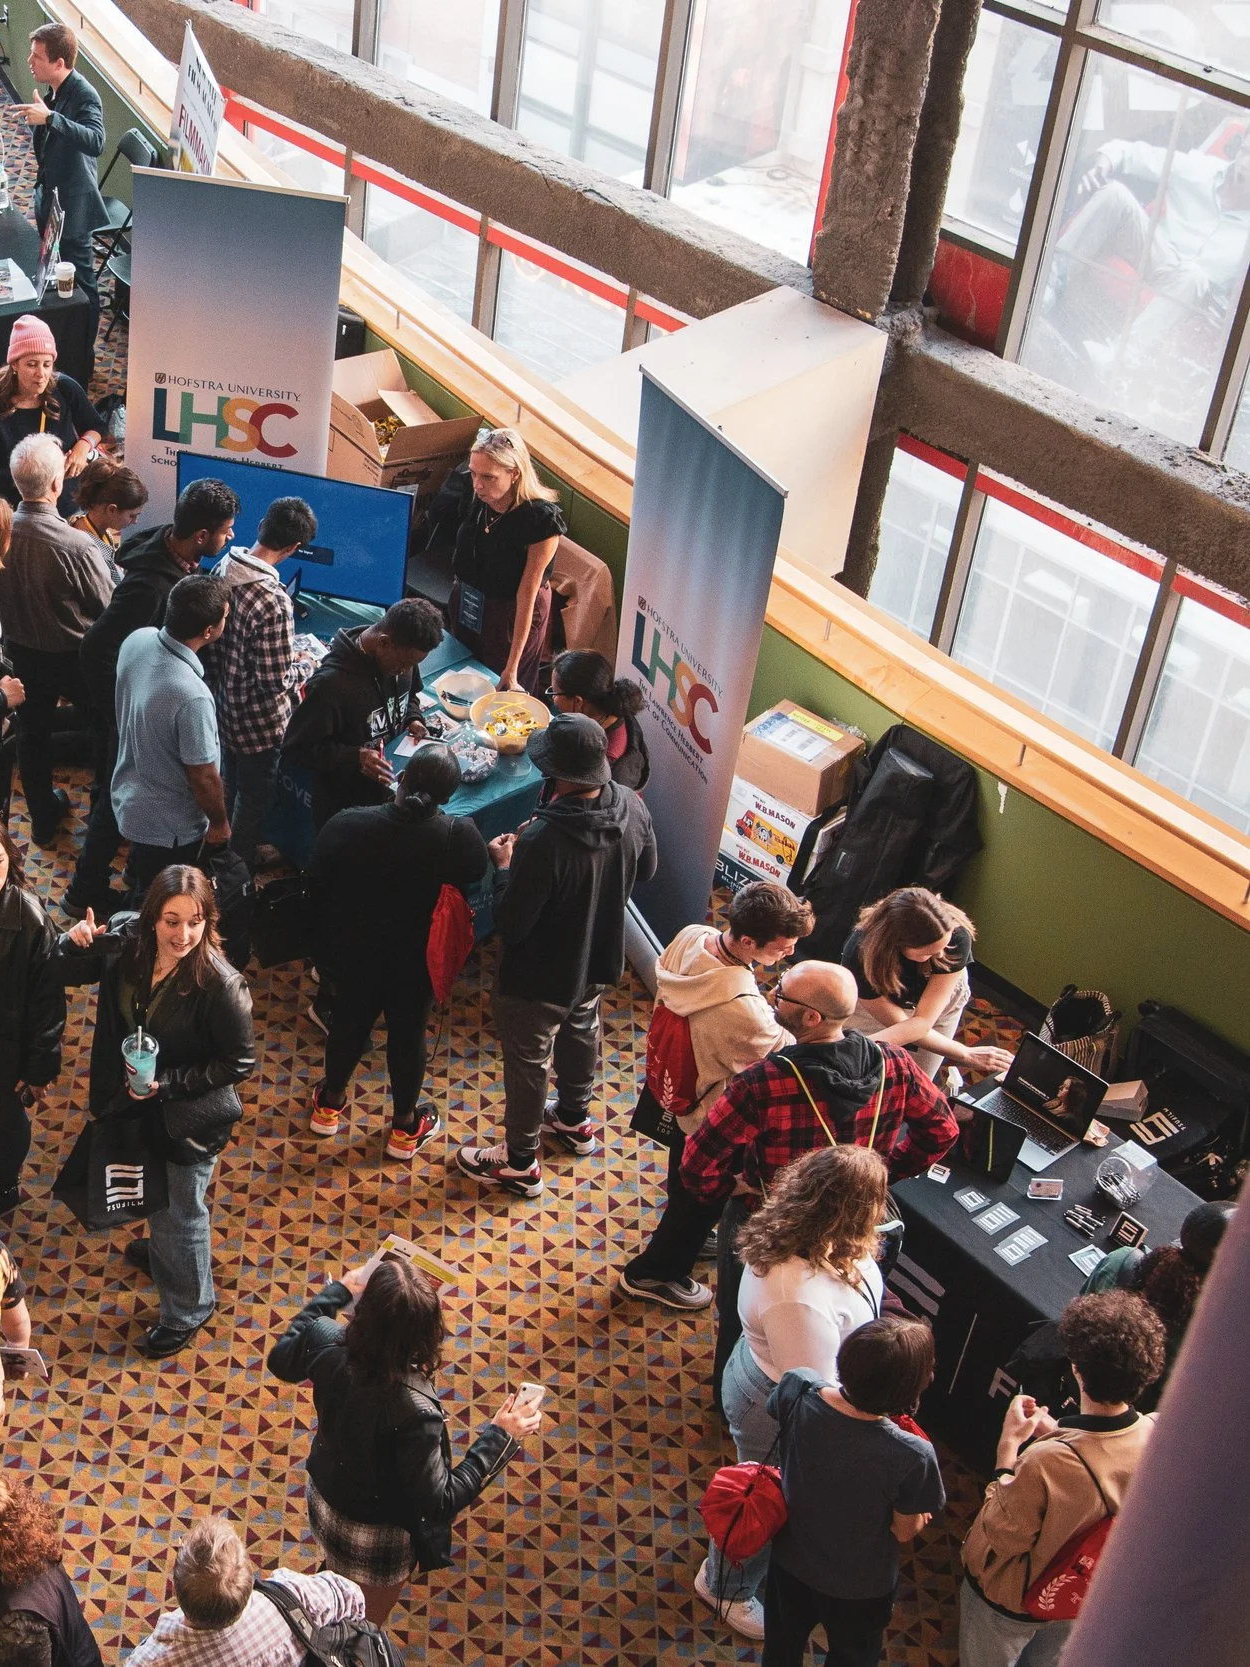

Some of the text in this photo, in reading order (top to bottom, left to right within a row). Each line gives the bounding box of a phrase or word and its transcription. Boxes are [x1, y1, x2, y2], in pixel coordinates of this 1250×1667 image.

[168, 375, 224, 391] HOFSTRA
[152, 387, 299, 458] LHSC
[151, 454, 177, 467] SCHO
[164, 446, 178, 457] TH
[646, 603, 723, 698] HOFSTRA UNIVERSITY
[632, 610, 719, 755] LHSC
[648, 691, 677, 734] LAWRENCE
[677, 728, 704, 764] HERBERT
[660, 719, 709, 785] COMMUNICATION
[754, 801, 796, 830] W.B.MASON
[715, 861, 757, 886] BLIZ
[738, 851, 781, 879] W.B.MASON
